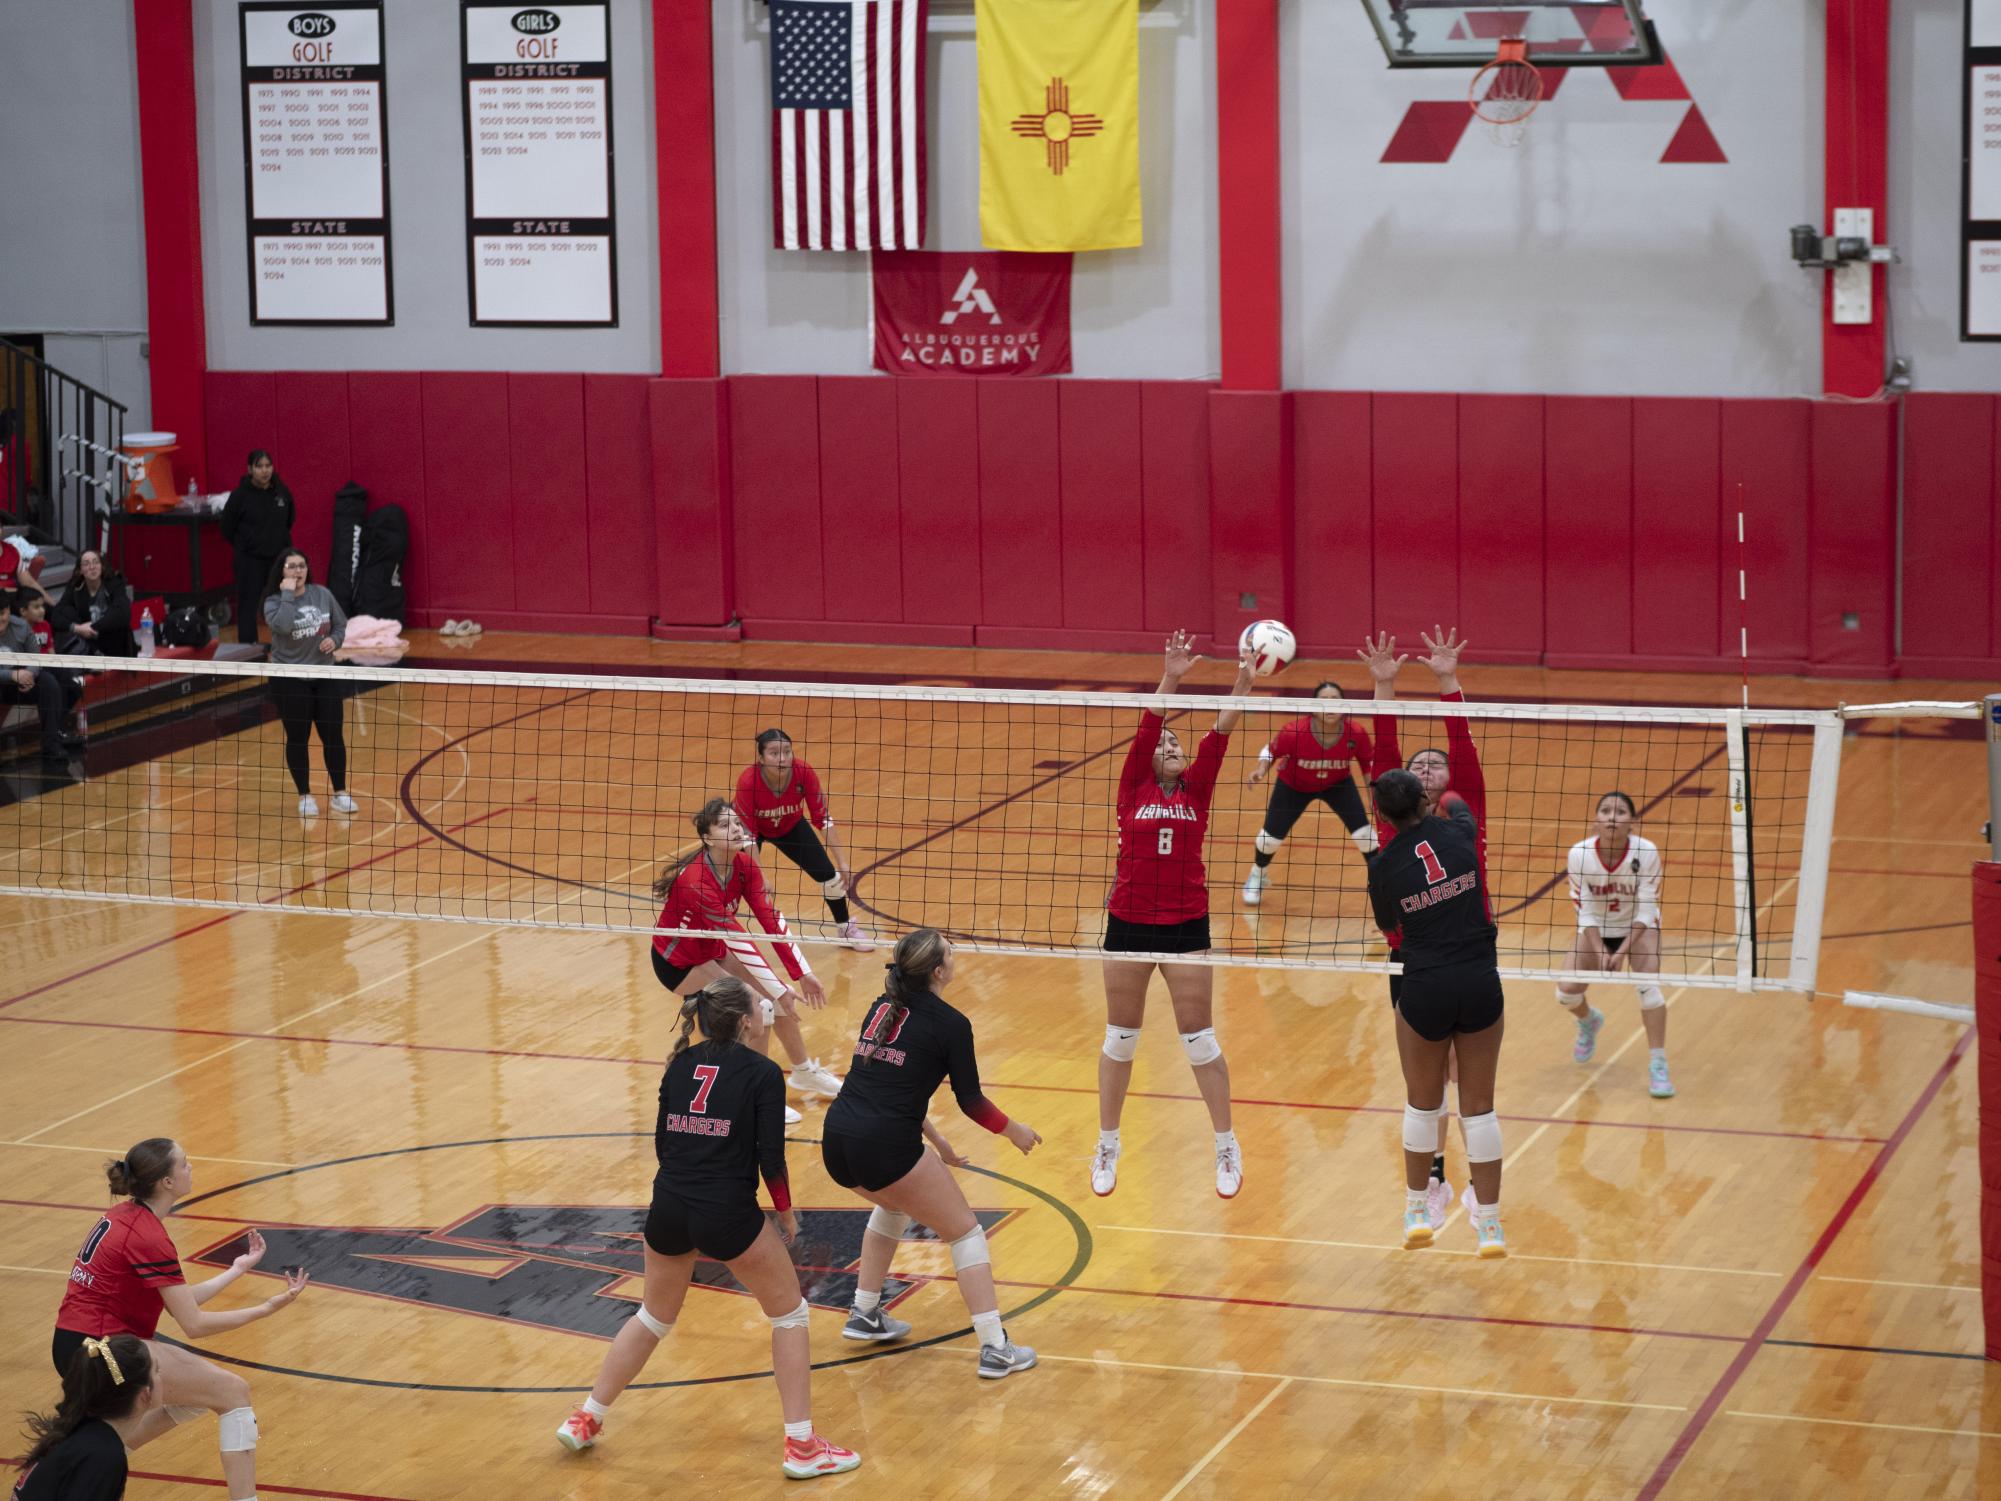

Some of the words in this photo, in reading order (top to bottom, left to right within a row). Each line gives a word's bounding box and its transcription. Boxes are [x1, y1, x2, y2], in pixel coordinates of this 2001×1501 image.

[293, 18, 330, 34] BOYS
[516, 14, 554, 30] GIRLS
[293, 42, 333, 62] GOLF
[516, 38, 558, 58] GOLF
[273, 67, 355, 80] DISTRICT
[494, 64, 579, 77] DISTRICT
[291, 222, 347, 233] STATE
[512, 222, 571, 233] STATE
[902, 333, 1039, 345] ALBUQUERQUE
[901, 345, 1040, 365] ACADEMY
[1158, 828, 1174, 855] 8
[1415, 840, 1447, 885] 1
[1400, 870, 1476, 913] CHARGERS
[1609, 898, 1620, 912] 2
[690, 1064, 720, 1114] 7
[666, 1113, 731, 1137] CHARGERS
